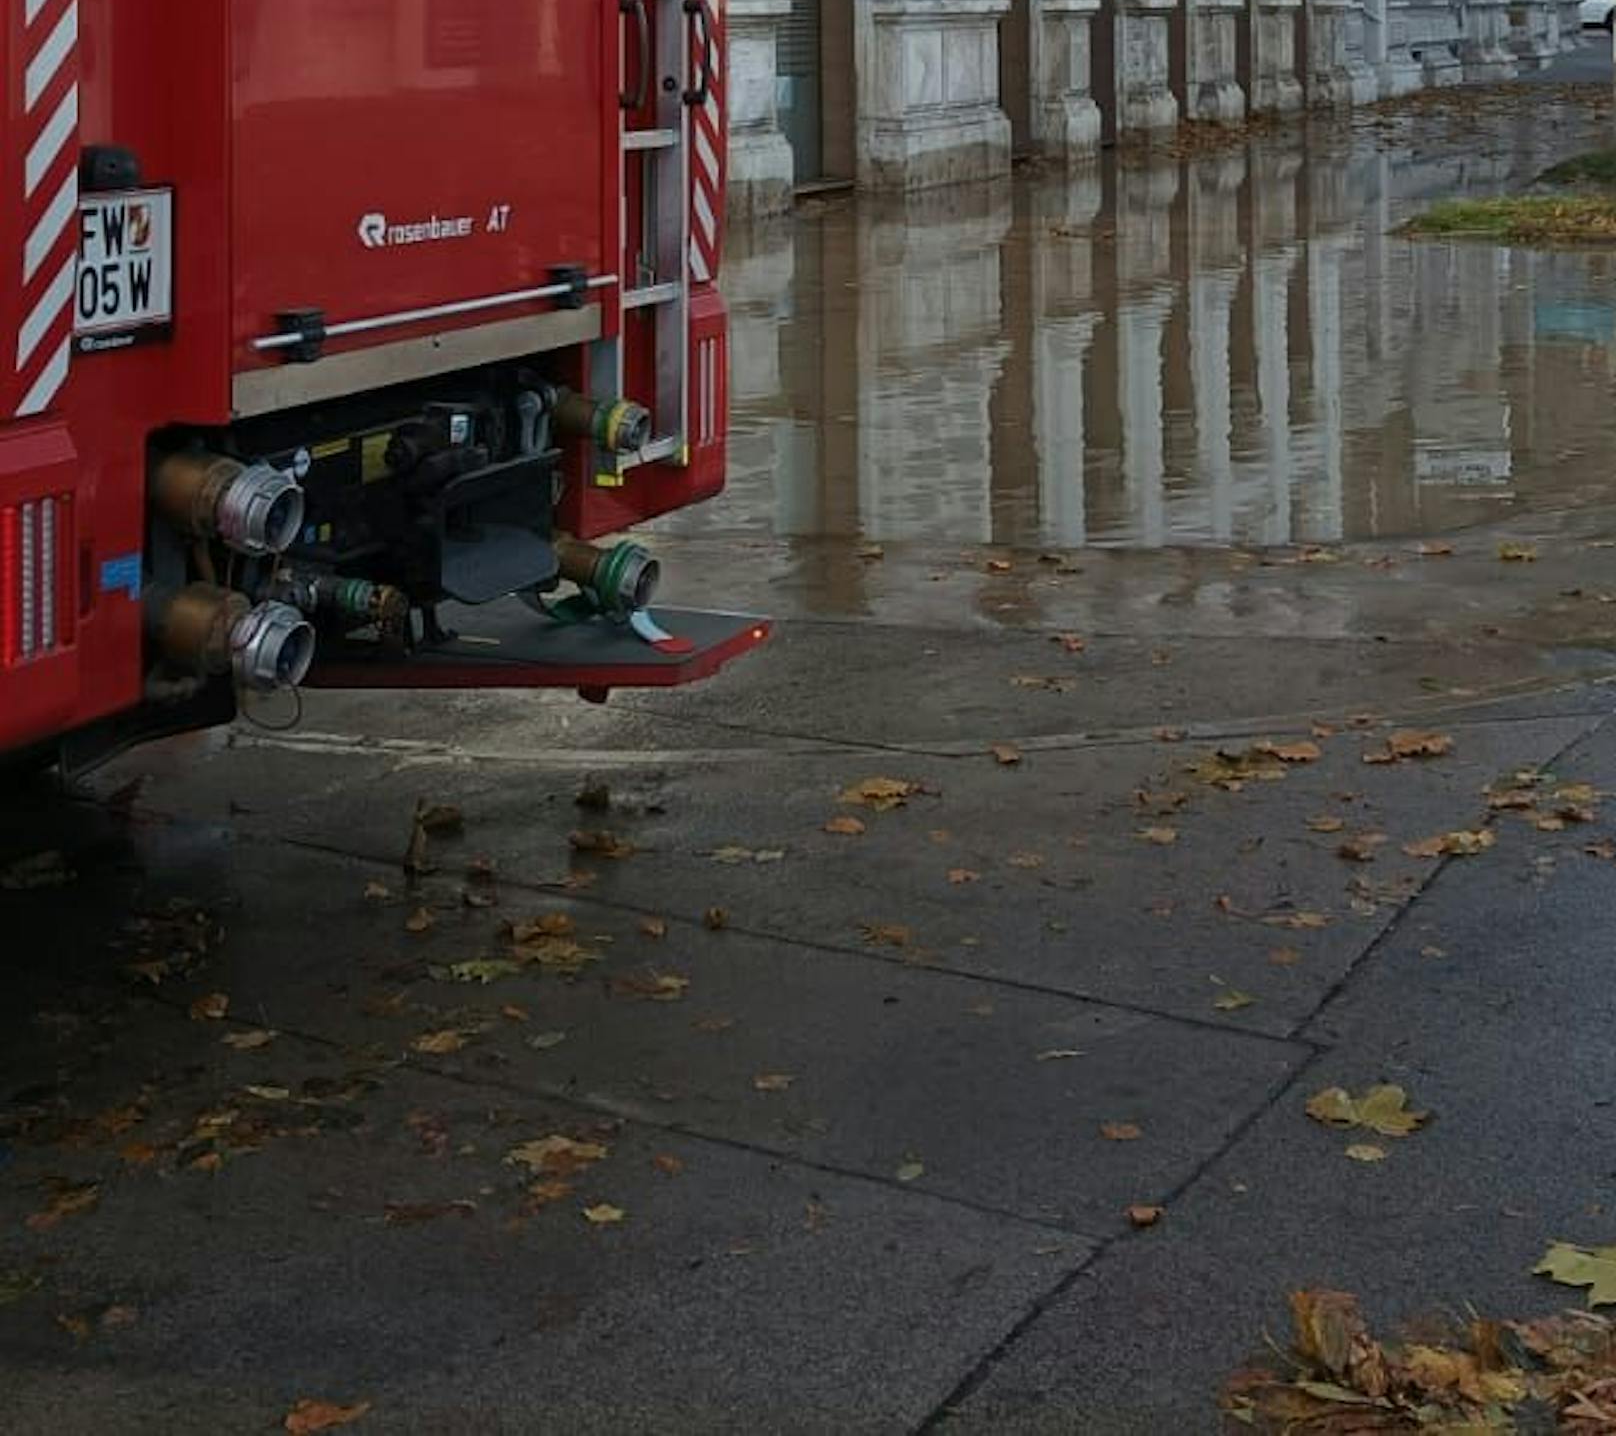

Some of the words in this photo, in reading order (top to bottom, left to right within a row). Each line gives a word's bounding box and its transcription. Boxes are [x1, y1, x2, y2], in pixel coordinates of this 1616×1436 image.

[80, 205, 125, 260] FW
[486, 205, 511, 233] AT
[129, 259, 151, 312] W
